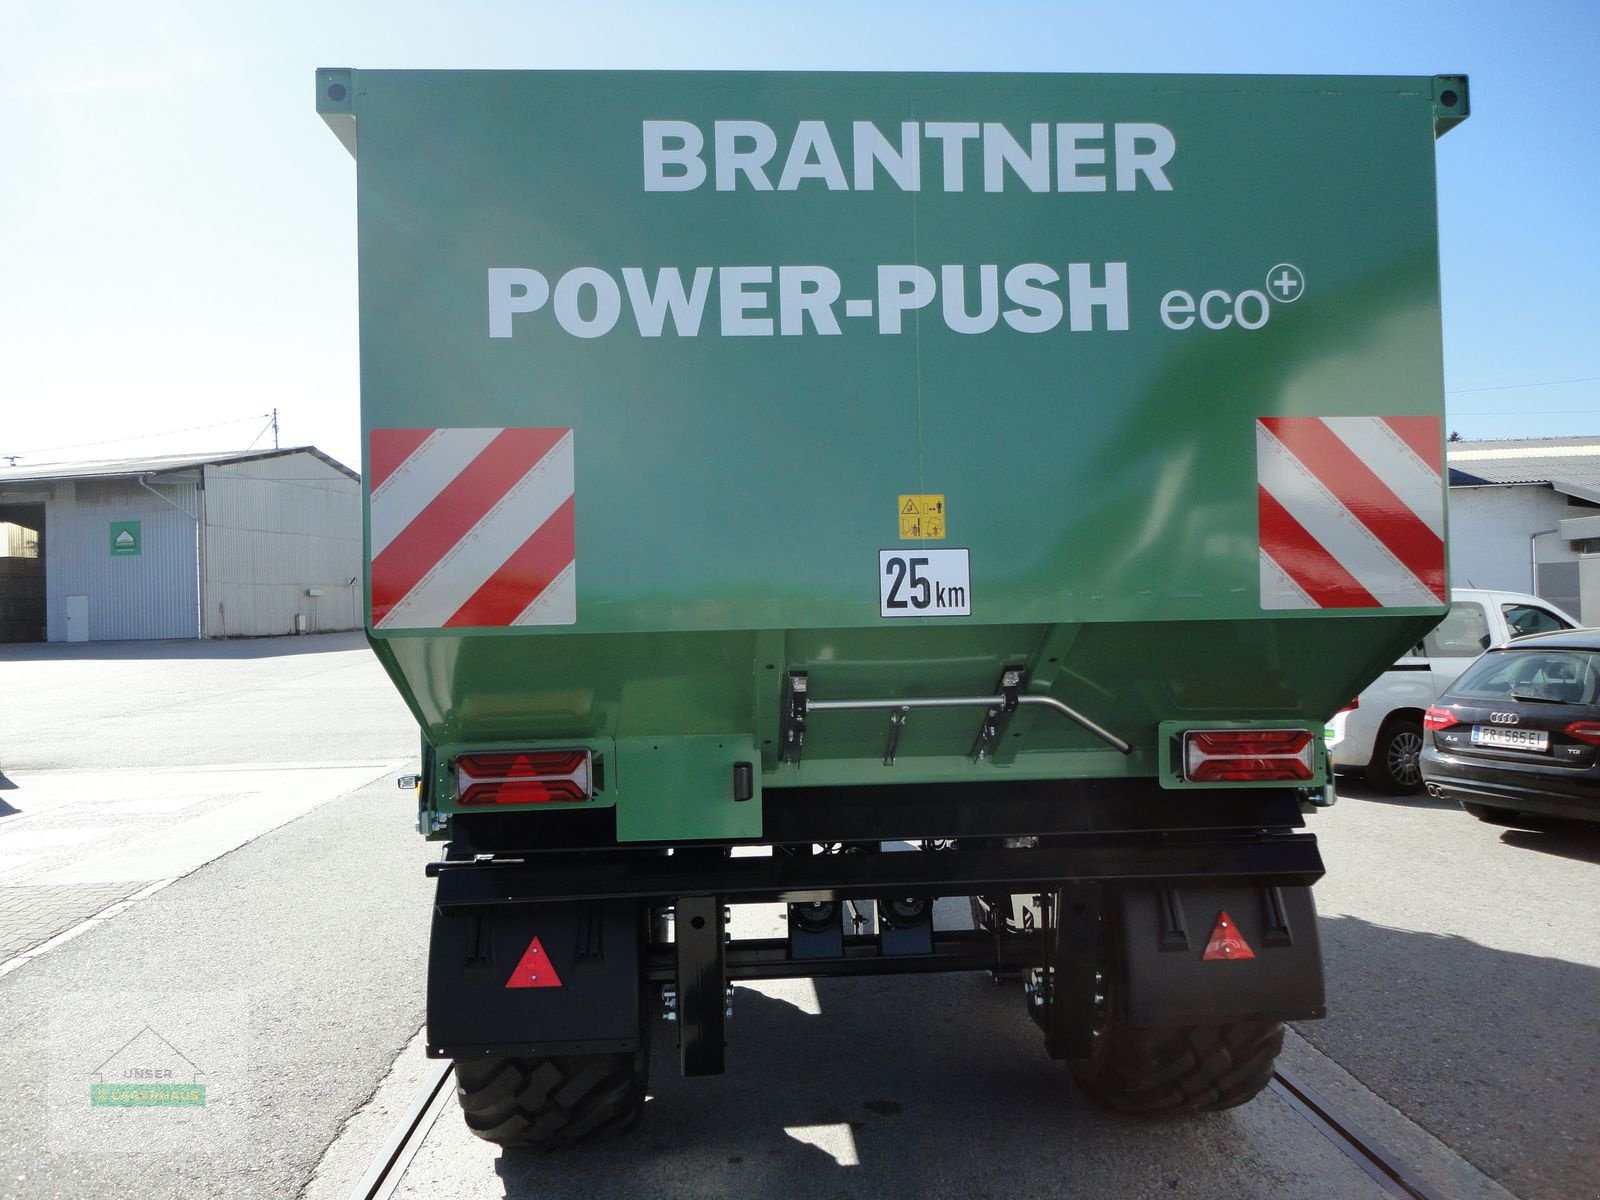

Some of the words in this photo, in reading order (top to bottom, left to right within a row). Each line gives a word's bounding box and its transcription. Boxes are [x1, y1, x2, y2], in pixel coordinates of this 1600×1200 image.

[642, 119, 1176, 193] BRANTNER
[487, 260, 1131, 340] POWER-PUSH
[886, 557, 931, 609] 25
[936, 581, 965, 608] km
[1482, 728, 1496, 741] FR
